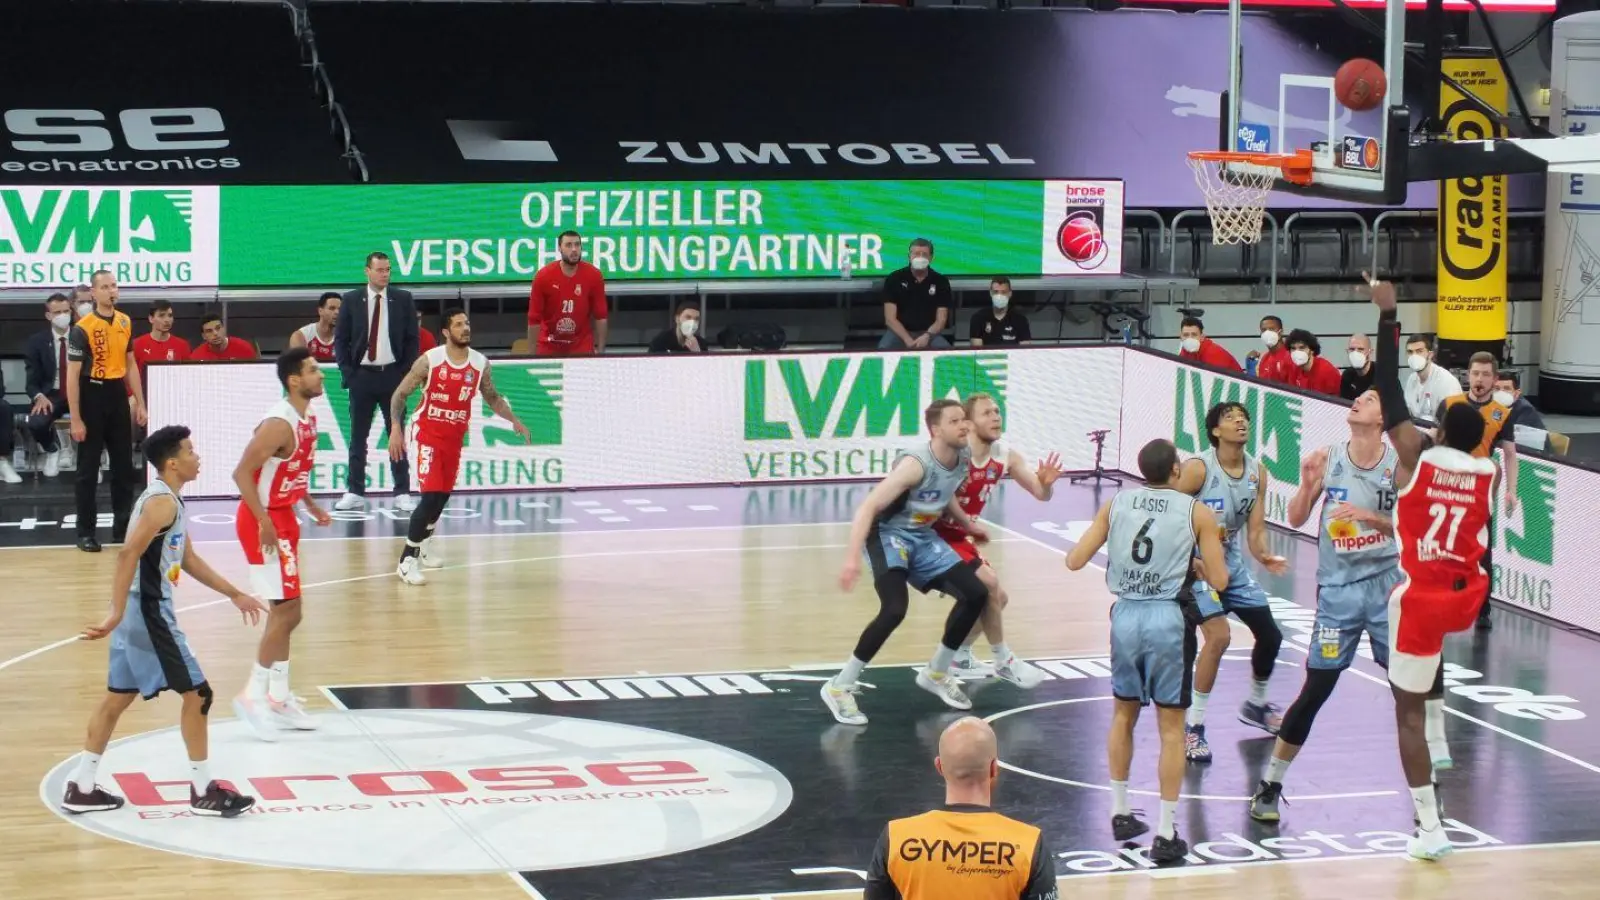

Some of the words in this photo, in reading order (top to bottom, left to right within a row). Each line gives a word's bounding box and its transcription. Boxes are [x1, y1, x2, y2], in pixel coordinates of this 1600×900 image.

[4, 107, 230, 151] se
[0, 156, 241, 172] echatronics
[618, 140, 1036, 165] ZUMTOBEL
[1066, 184, 1106, 196] brose
[1456, 120, 1484, 249] rado
[520, 189, 763, 229] OFFIZIELLER
[1066, 196, 1105, 207] bamberg
[1492, 174, 1502, 239] BAMBE
[0, 189, 120, 253] VM
[391, 233, 883, 277] VERSICHRUNGPARTNER
[0, 261, 192, 283] ERSICHRUNG
[562, 299, 574, 313] 20
[744, 355, 921, 440] LVM
[745, 447, 904, 479] VERSICH
[1432, 467, 1477, 491] THOMPSON
[1132, 496, 1169, 513] LASISI
[1376, 489, 1395, 511] 15
[1131, 518, 1156, 565] 6
[1332, 531, 1386, 551] nippon
[1428, 502, 1468, 551] 27
[466, 673, 774, 703] PUMA
[111, 760, 709, 807] brose
[136, 801, 373, 820] Exllence
[388, 799, 426, 810] in
[444, 784, 729, 808] Mechatronics
[900, 838, 1016, 866] GYMPER
[1055, 818, 1505, 871] andstad
